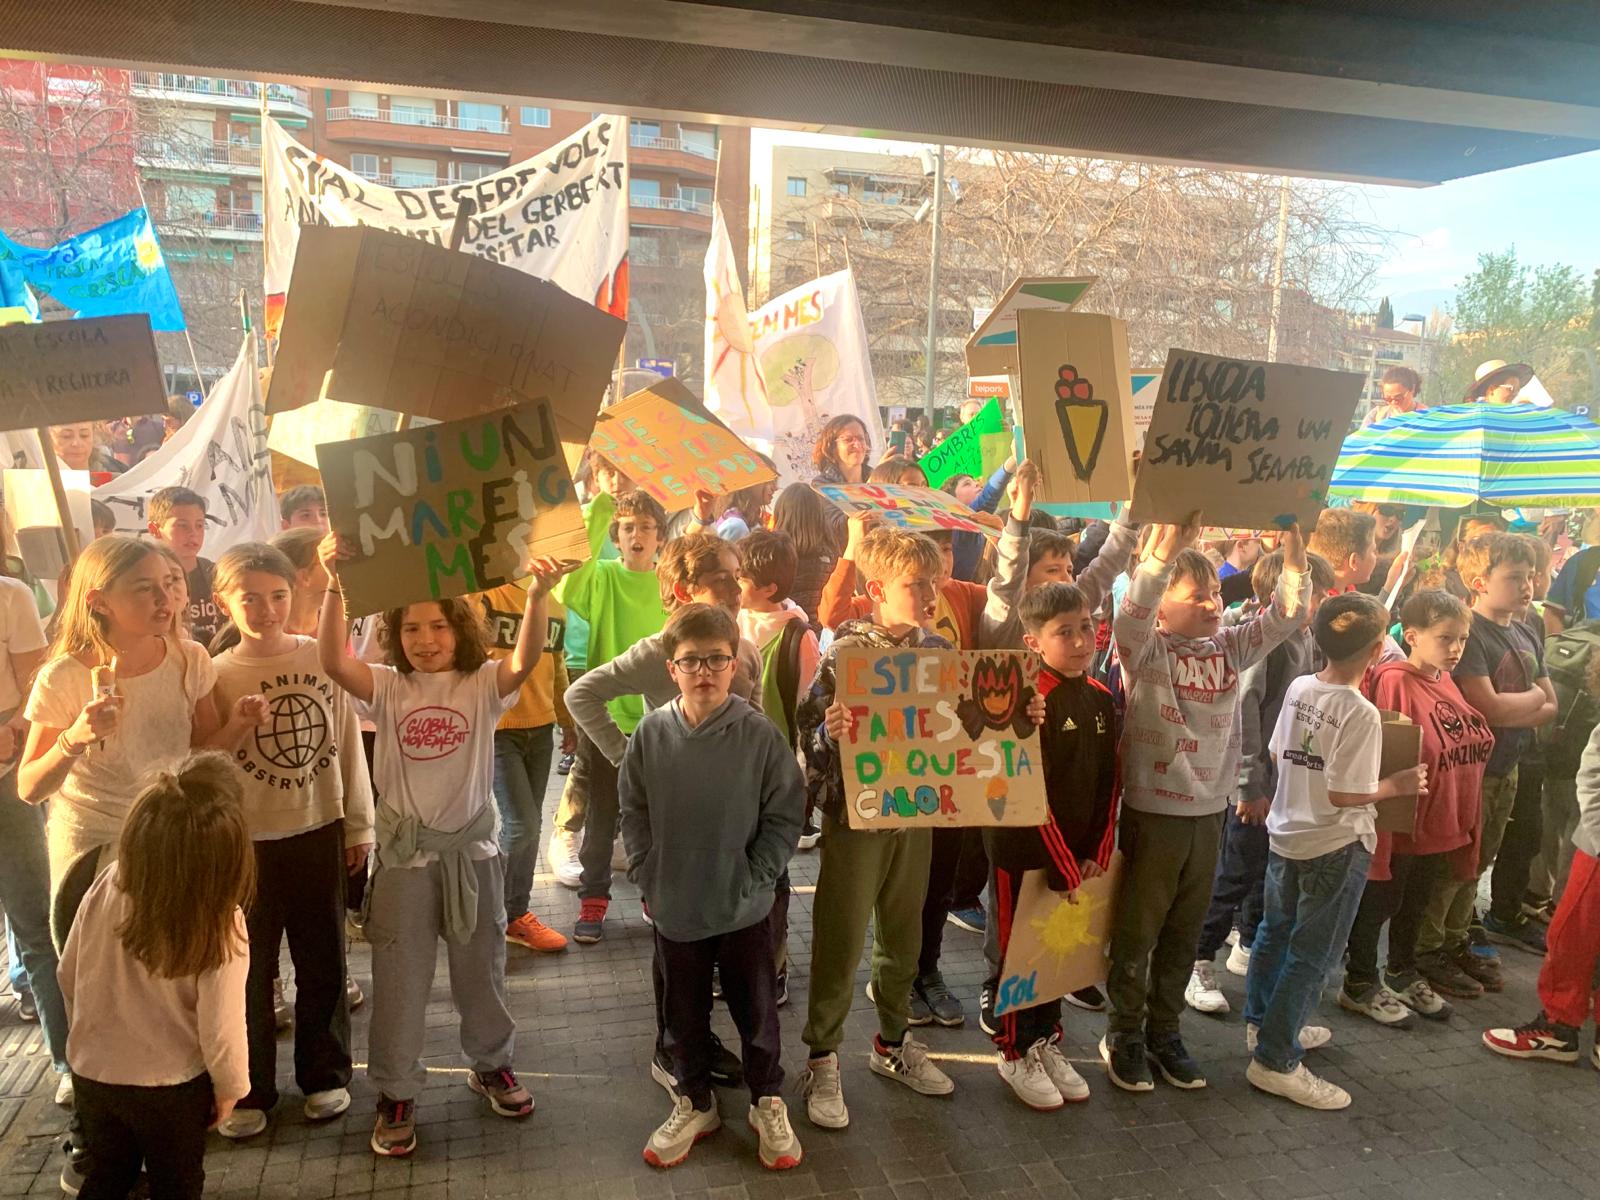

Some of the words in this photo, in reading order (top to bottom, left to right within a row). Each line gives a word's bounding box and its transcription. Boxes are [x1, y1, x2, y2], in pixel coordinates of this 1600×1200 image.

[463, 214, 515, 243] DEL
[522, 162, 624, 224] GERBERT
[974, 385, 1004, 393] telpark
[459, 402, 557, 471] UN
[927, 413, 985, 473] OMBRES
[847, 652, 958, 696] ESTEM
[402, 730, 470, 752] MOVEMENT
[406, 716, 458, 736] GLOBAL
[848, 700, 961, 745] FARTES
[1429, 712, 1446, 749] I
[236, 745, 338, 790] OBSERVATOR
[855, 784, 959, 820] CALOR
